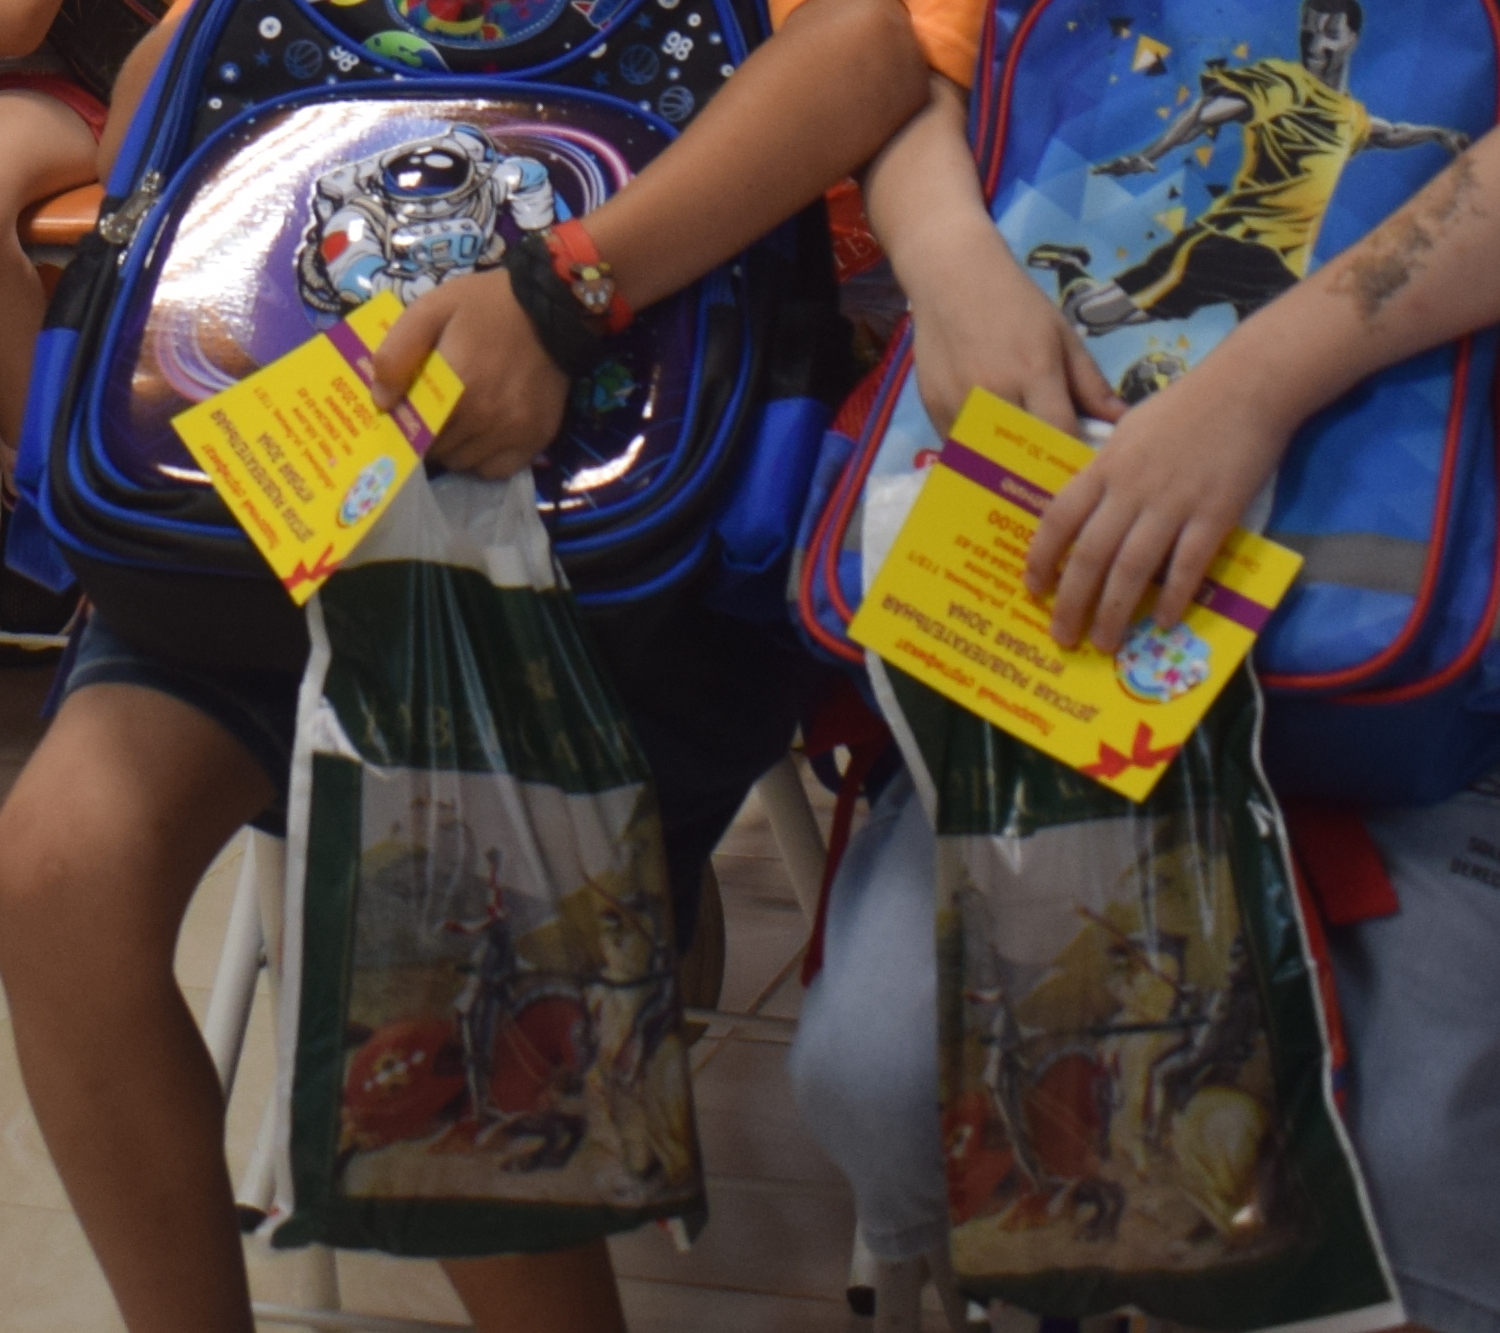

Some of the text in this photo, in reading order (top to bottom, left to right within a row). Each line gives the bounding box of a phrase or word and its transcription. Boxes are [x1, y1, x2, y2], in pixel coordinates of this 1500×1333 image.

[661, 30, 694, 61] 98
[881, 594, 1101, 724] ДЕТСКАЯ РАЗВЛЕКАТЕЛЬНАЯ
[949, 602, 1066, 678] ИГРОВАЯ ЗОНА
